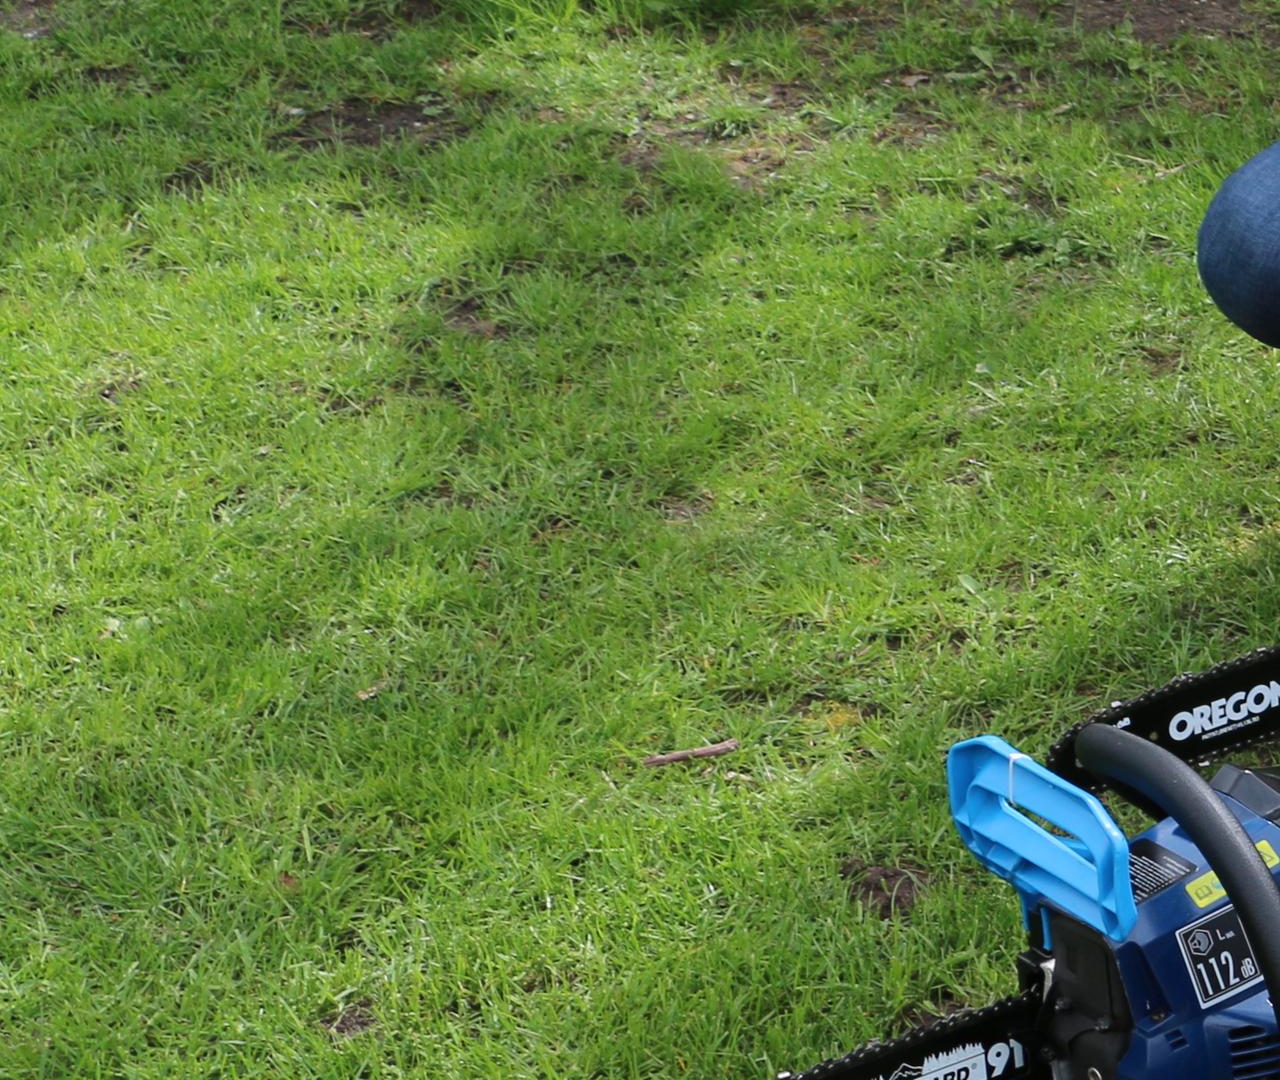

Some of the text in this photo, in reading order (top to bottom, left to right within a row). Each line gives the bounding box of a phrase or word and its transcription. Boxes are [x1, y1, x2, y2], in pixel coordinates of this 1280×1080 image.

[1196, 951, 1256, 996] 112 dB
[986, 1038, 1024, 1078] 91
